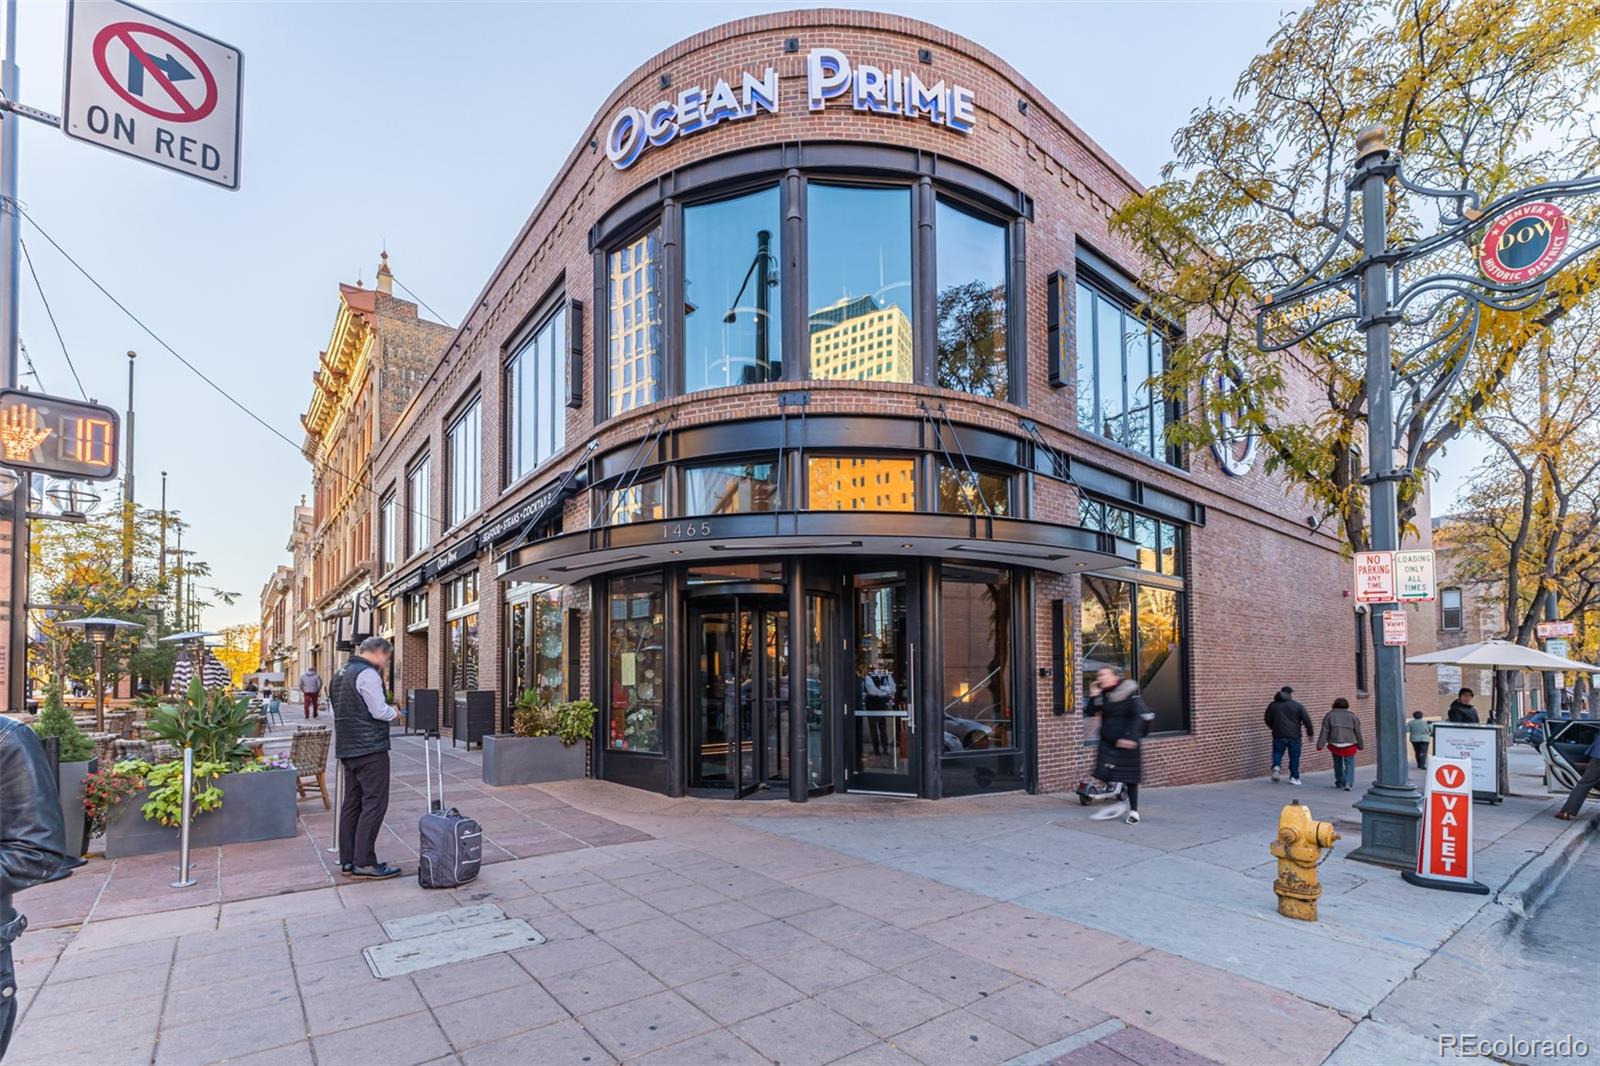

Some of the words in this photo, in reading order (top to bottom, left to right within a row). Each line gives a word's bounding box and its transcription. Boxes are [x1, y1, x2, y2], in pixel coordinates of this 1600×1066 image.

[605, 67, 780, 170] OCEAN
[807, 47, 977, 135] PRIME
[87, 105, 136, 145] ON
[156, 127, 221, 172] RED
[1498, 204, 1546, 227] DENVER
[1484, 257, 1522, 281] HISTORIC
[1527, 235, 1566, 276] DISTRICT
[75, 416, 113, 466] 10
[502, 512, 520, 530] STEAKS
[663, 521, 711, 539] 1465
[1366, 554, 1381, 565] NO
[1397, 554, 1431, 563] LOADING
[1358, 564, 1390, 575] PARKING
[1404, 565, 1424, 573] ONLY
[1442, 768, 1459, 785] V
[1441, 795, 1458, 872] VALET
